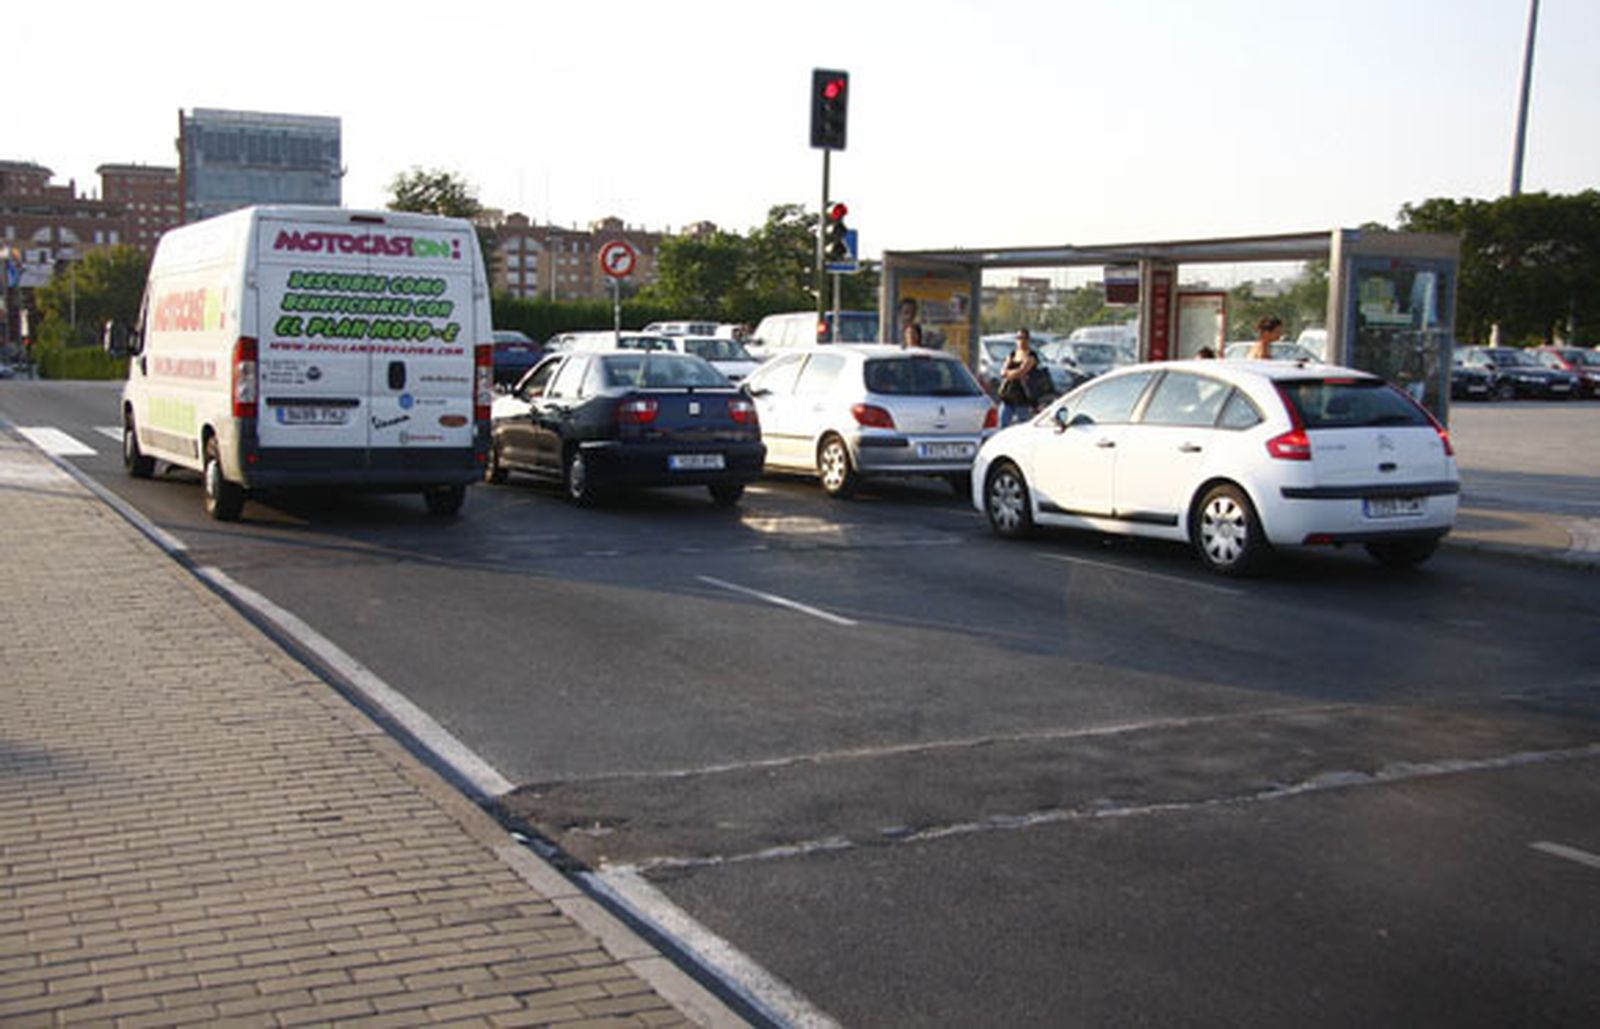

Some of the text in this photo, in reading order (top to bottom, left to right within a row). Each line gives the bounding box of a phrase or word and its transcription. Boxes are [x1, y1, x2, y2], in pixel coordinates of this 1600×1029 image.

[287, 271, 447, 296] DESCUBRE COMO
[280, 292, 454, 318] BENEFICIARTE CON
[274, 316, 303, 337] EL
[306, 317, 368, 339] PLAN
